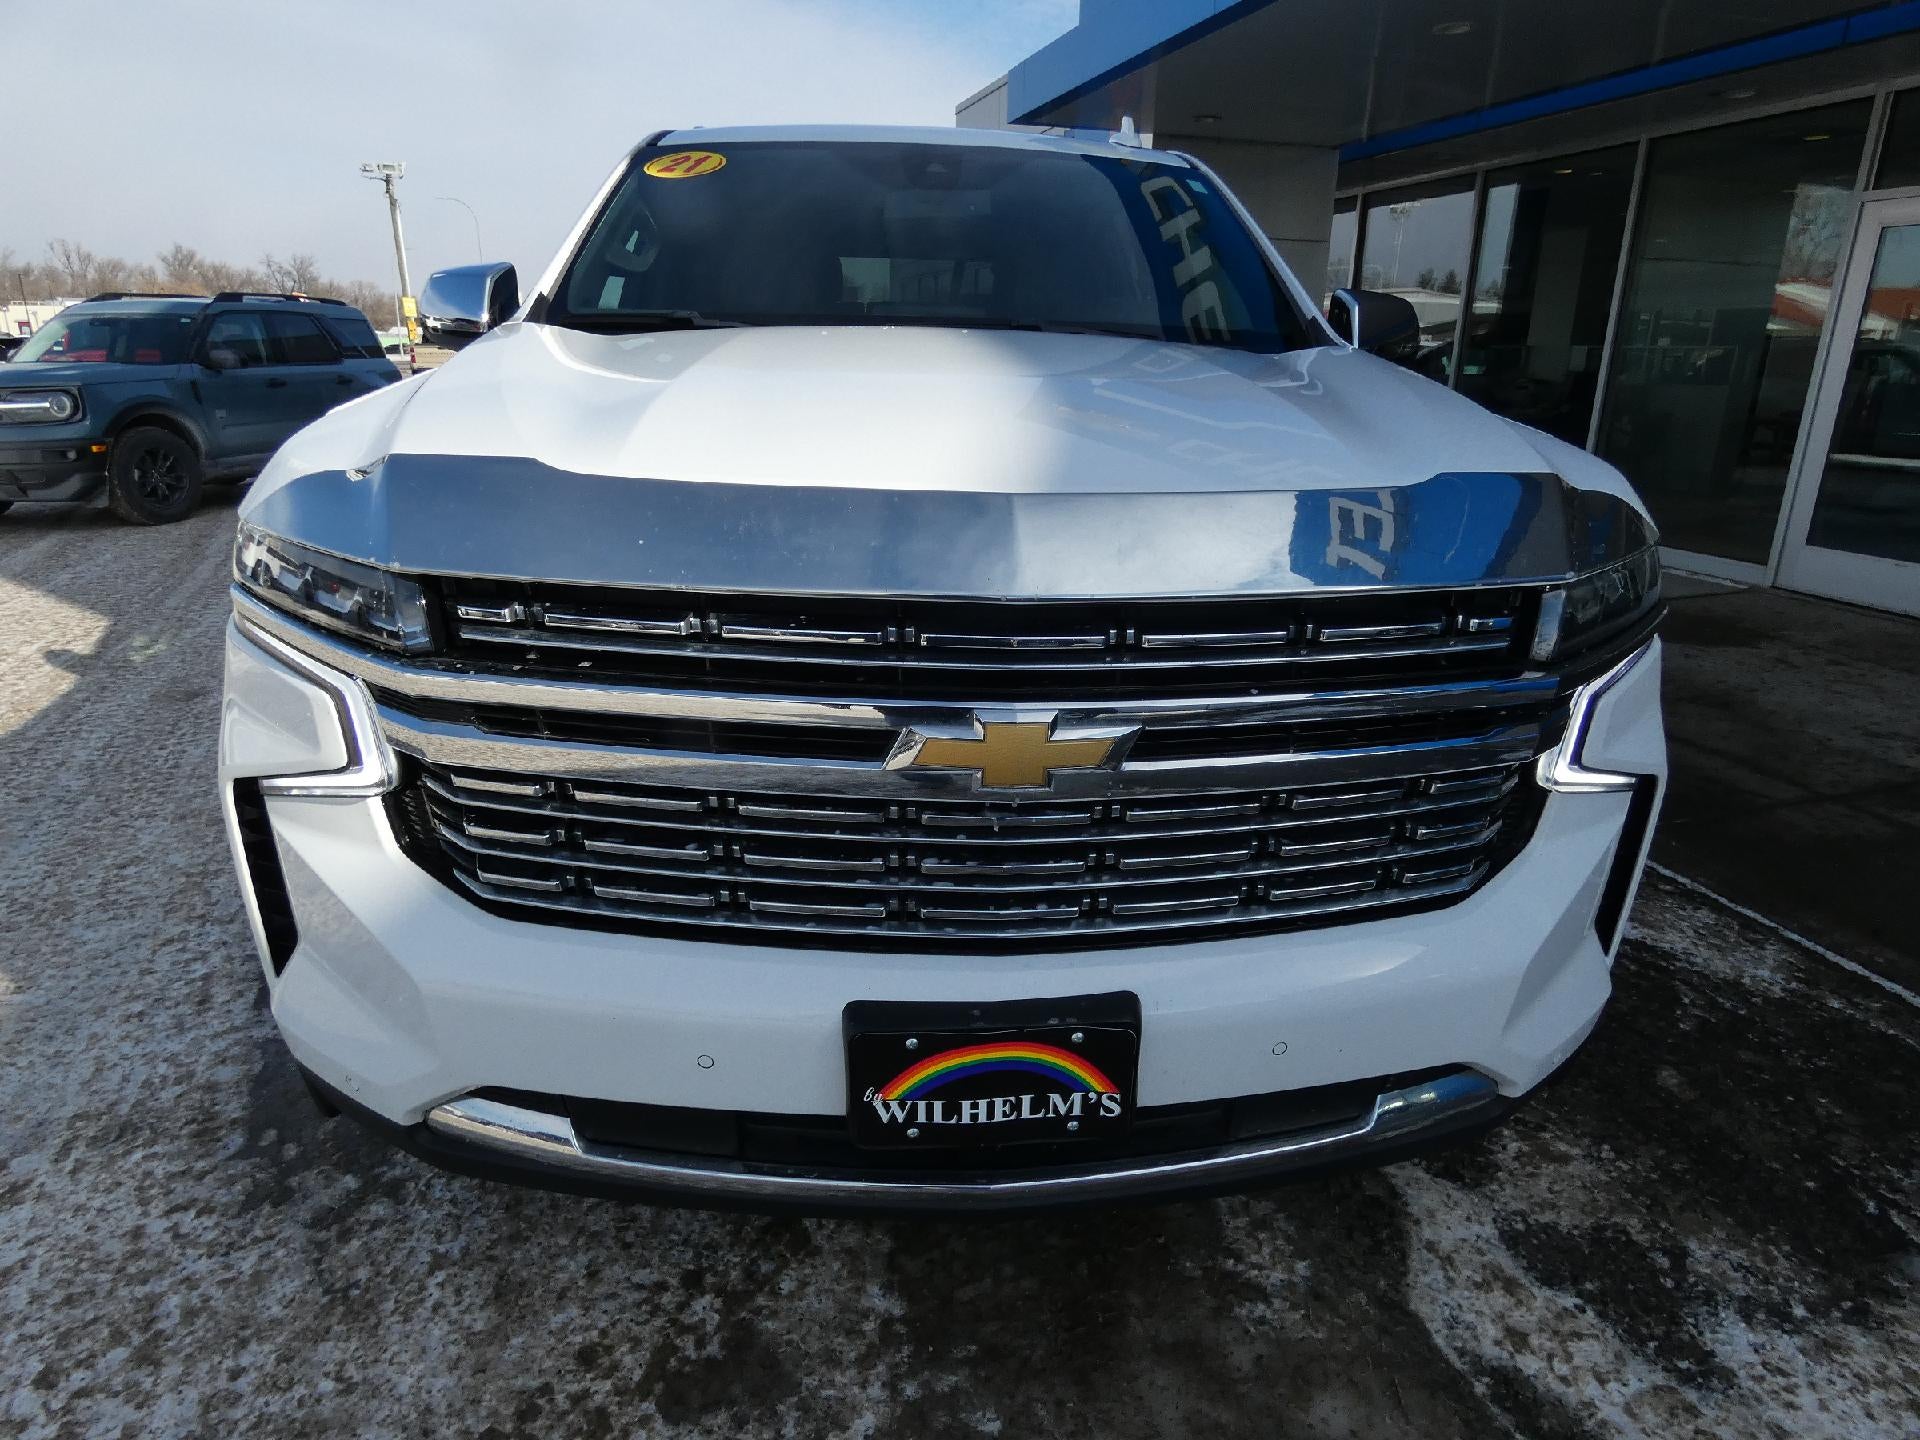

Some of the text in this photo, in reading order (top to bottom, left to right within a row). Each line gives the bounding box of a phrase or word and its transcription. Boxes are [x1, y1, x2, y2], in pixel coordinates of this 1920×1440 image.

[657, 155, 712, 173] 21
[863, 1086, 1122, 1124] by WILHELM'S
